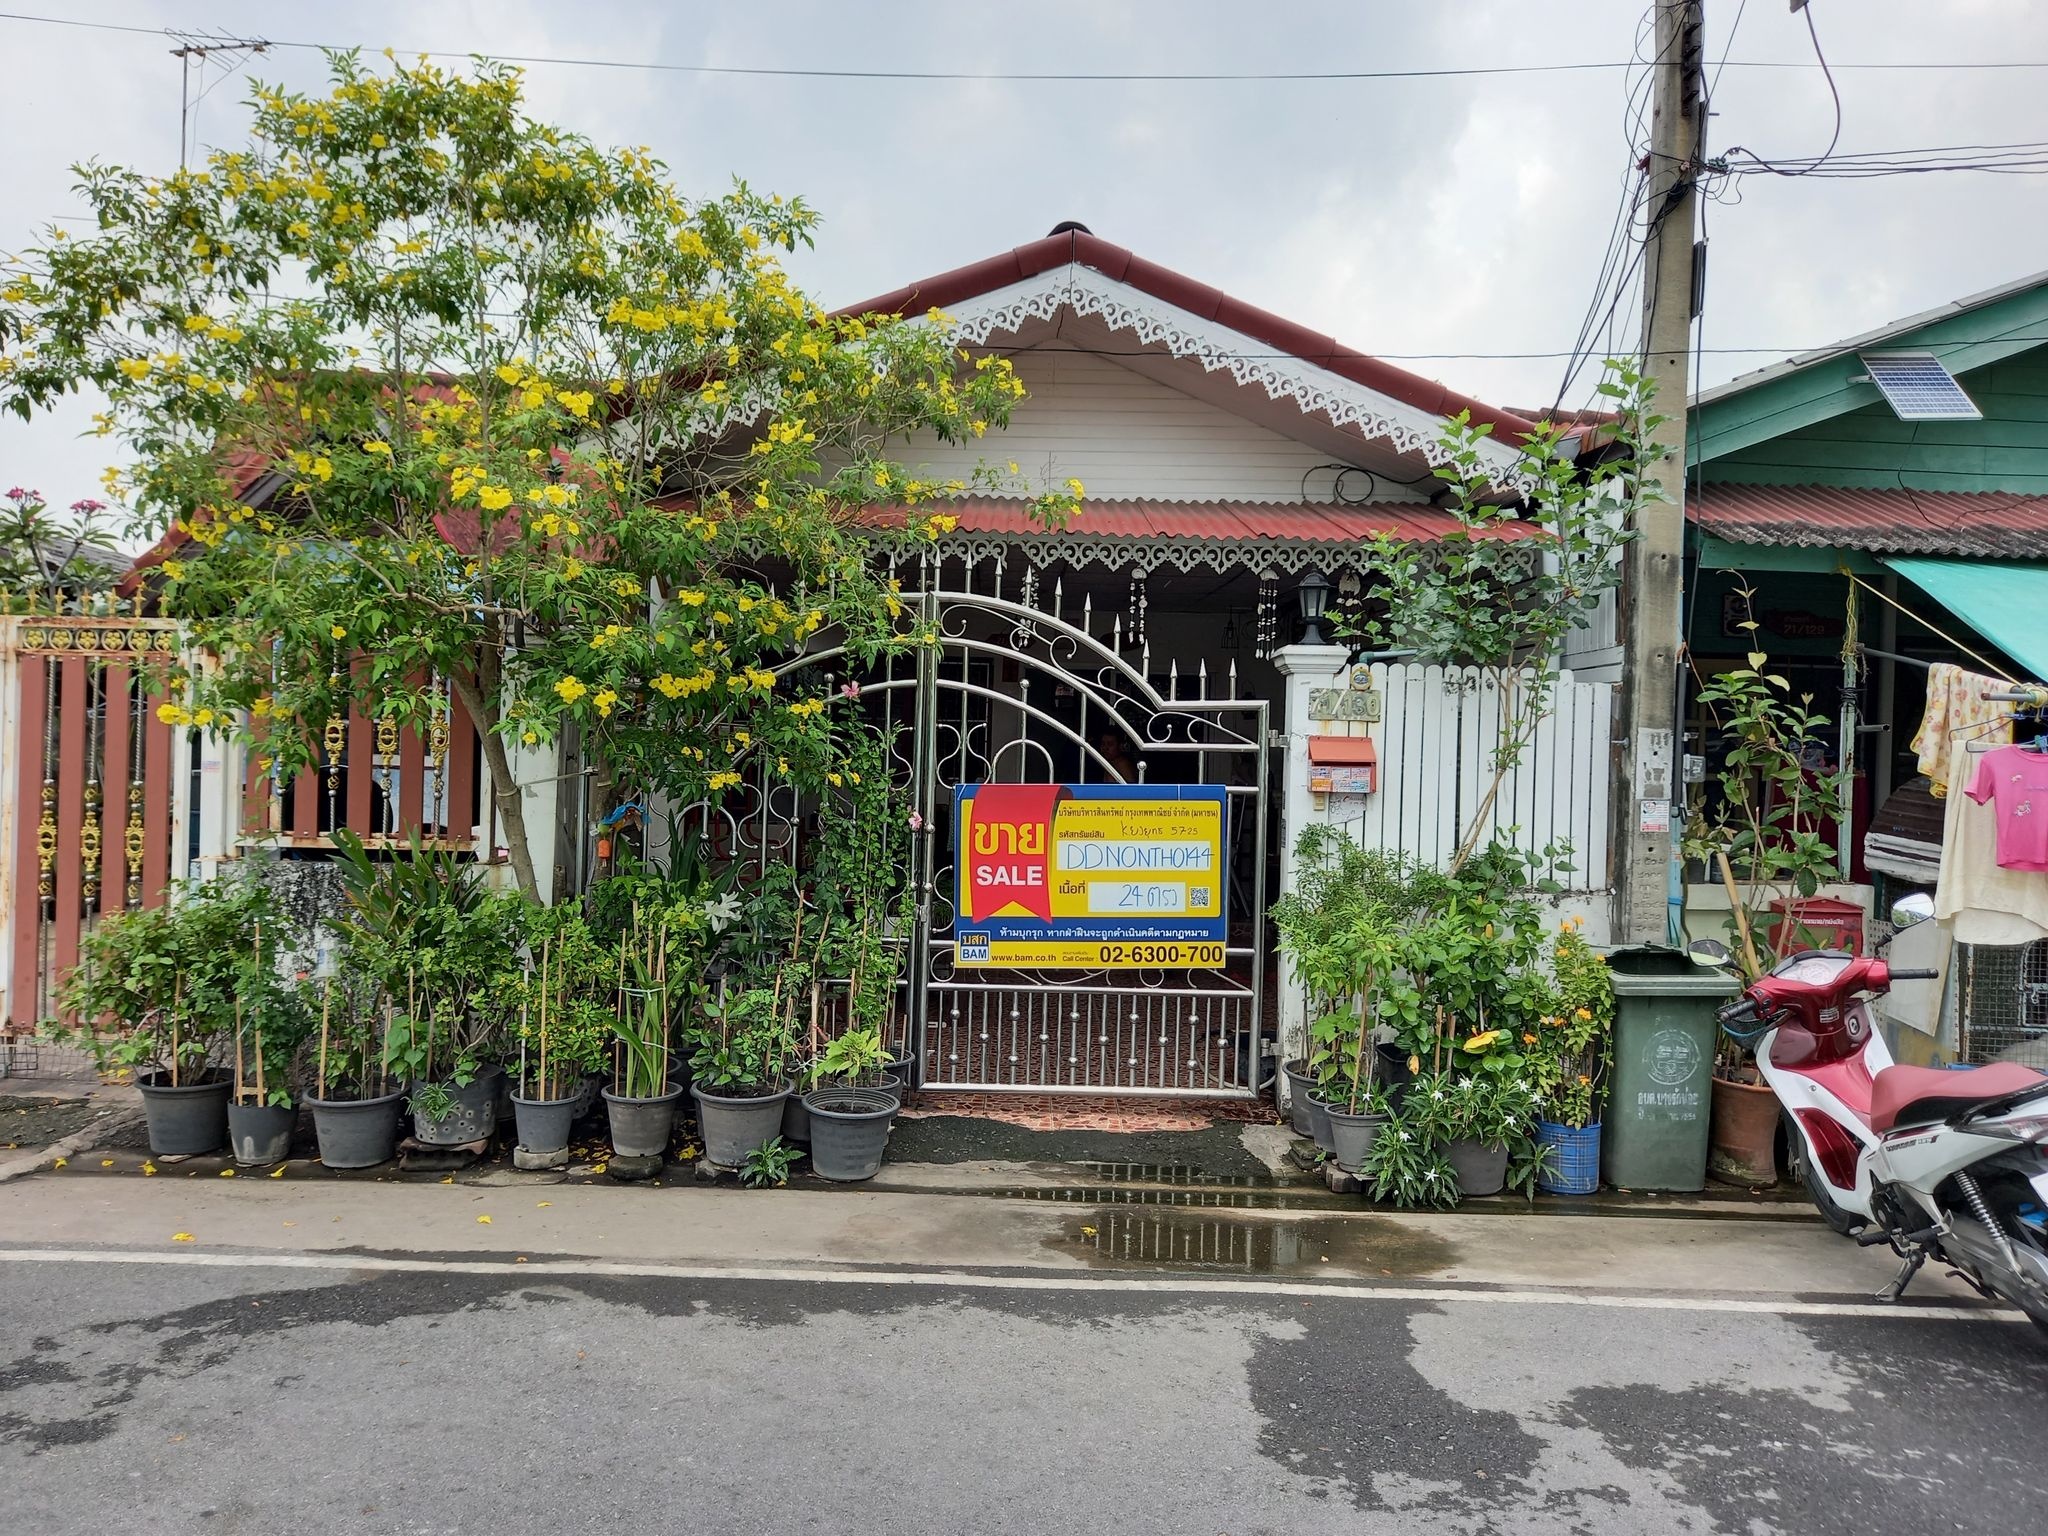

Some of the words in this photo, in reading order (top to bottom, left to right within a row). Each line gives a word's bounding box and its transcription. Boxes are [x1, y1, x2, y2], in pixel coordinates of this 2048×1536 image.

[1173, 807, 1190, 817] จำกัด
[1191, 808, 1218, 819] (มหาชน)
[975, 822, 1045, 855] ขาย
[1058, 829, 1105, 839] รหัสทรัพย์สิน
[976, 865, 1043, 886] SALE
[1058, 879, 1086, 895] เนื้อที่
[962, 934, 987, 945] บสก
[1000, 927, 1043, 940] ห้ามบุกรุก
[962, 948, 987, 959] BAM
[991, 953, 1057, 962] www.bam.co.th
[1100, 945, 1223, 963] 02-6300-700
